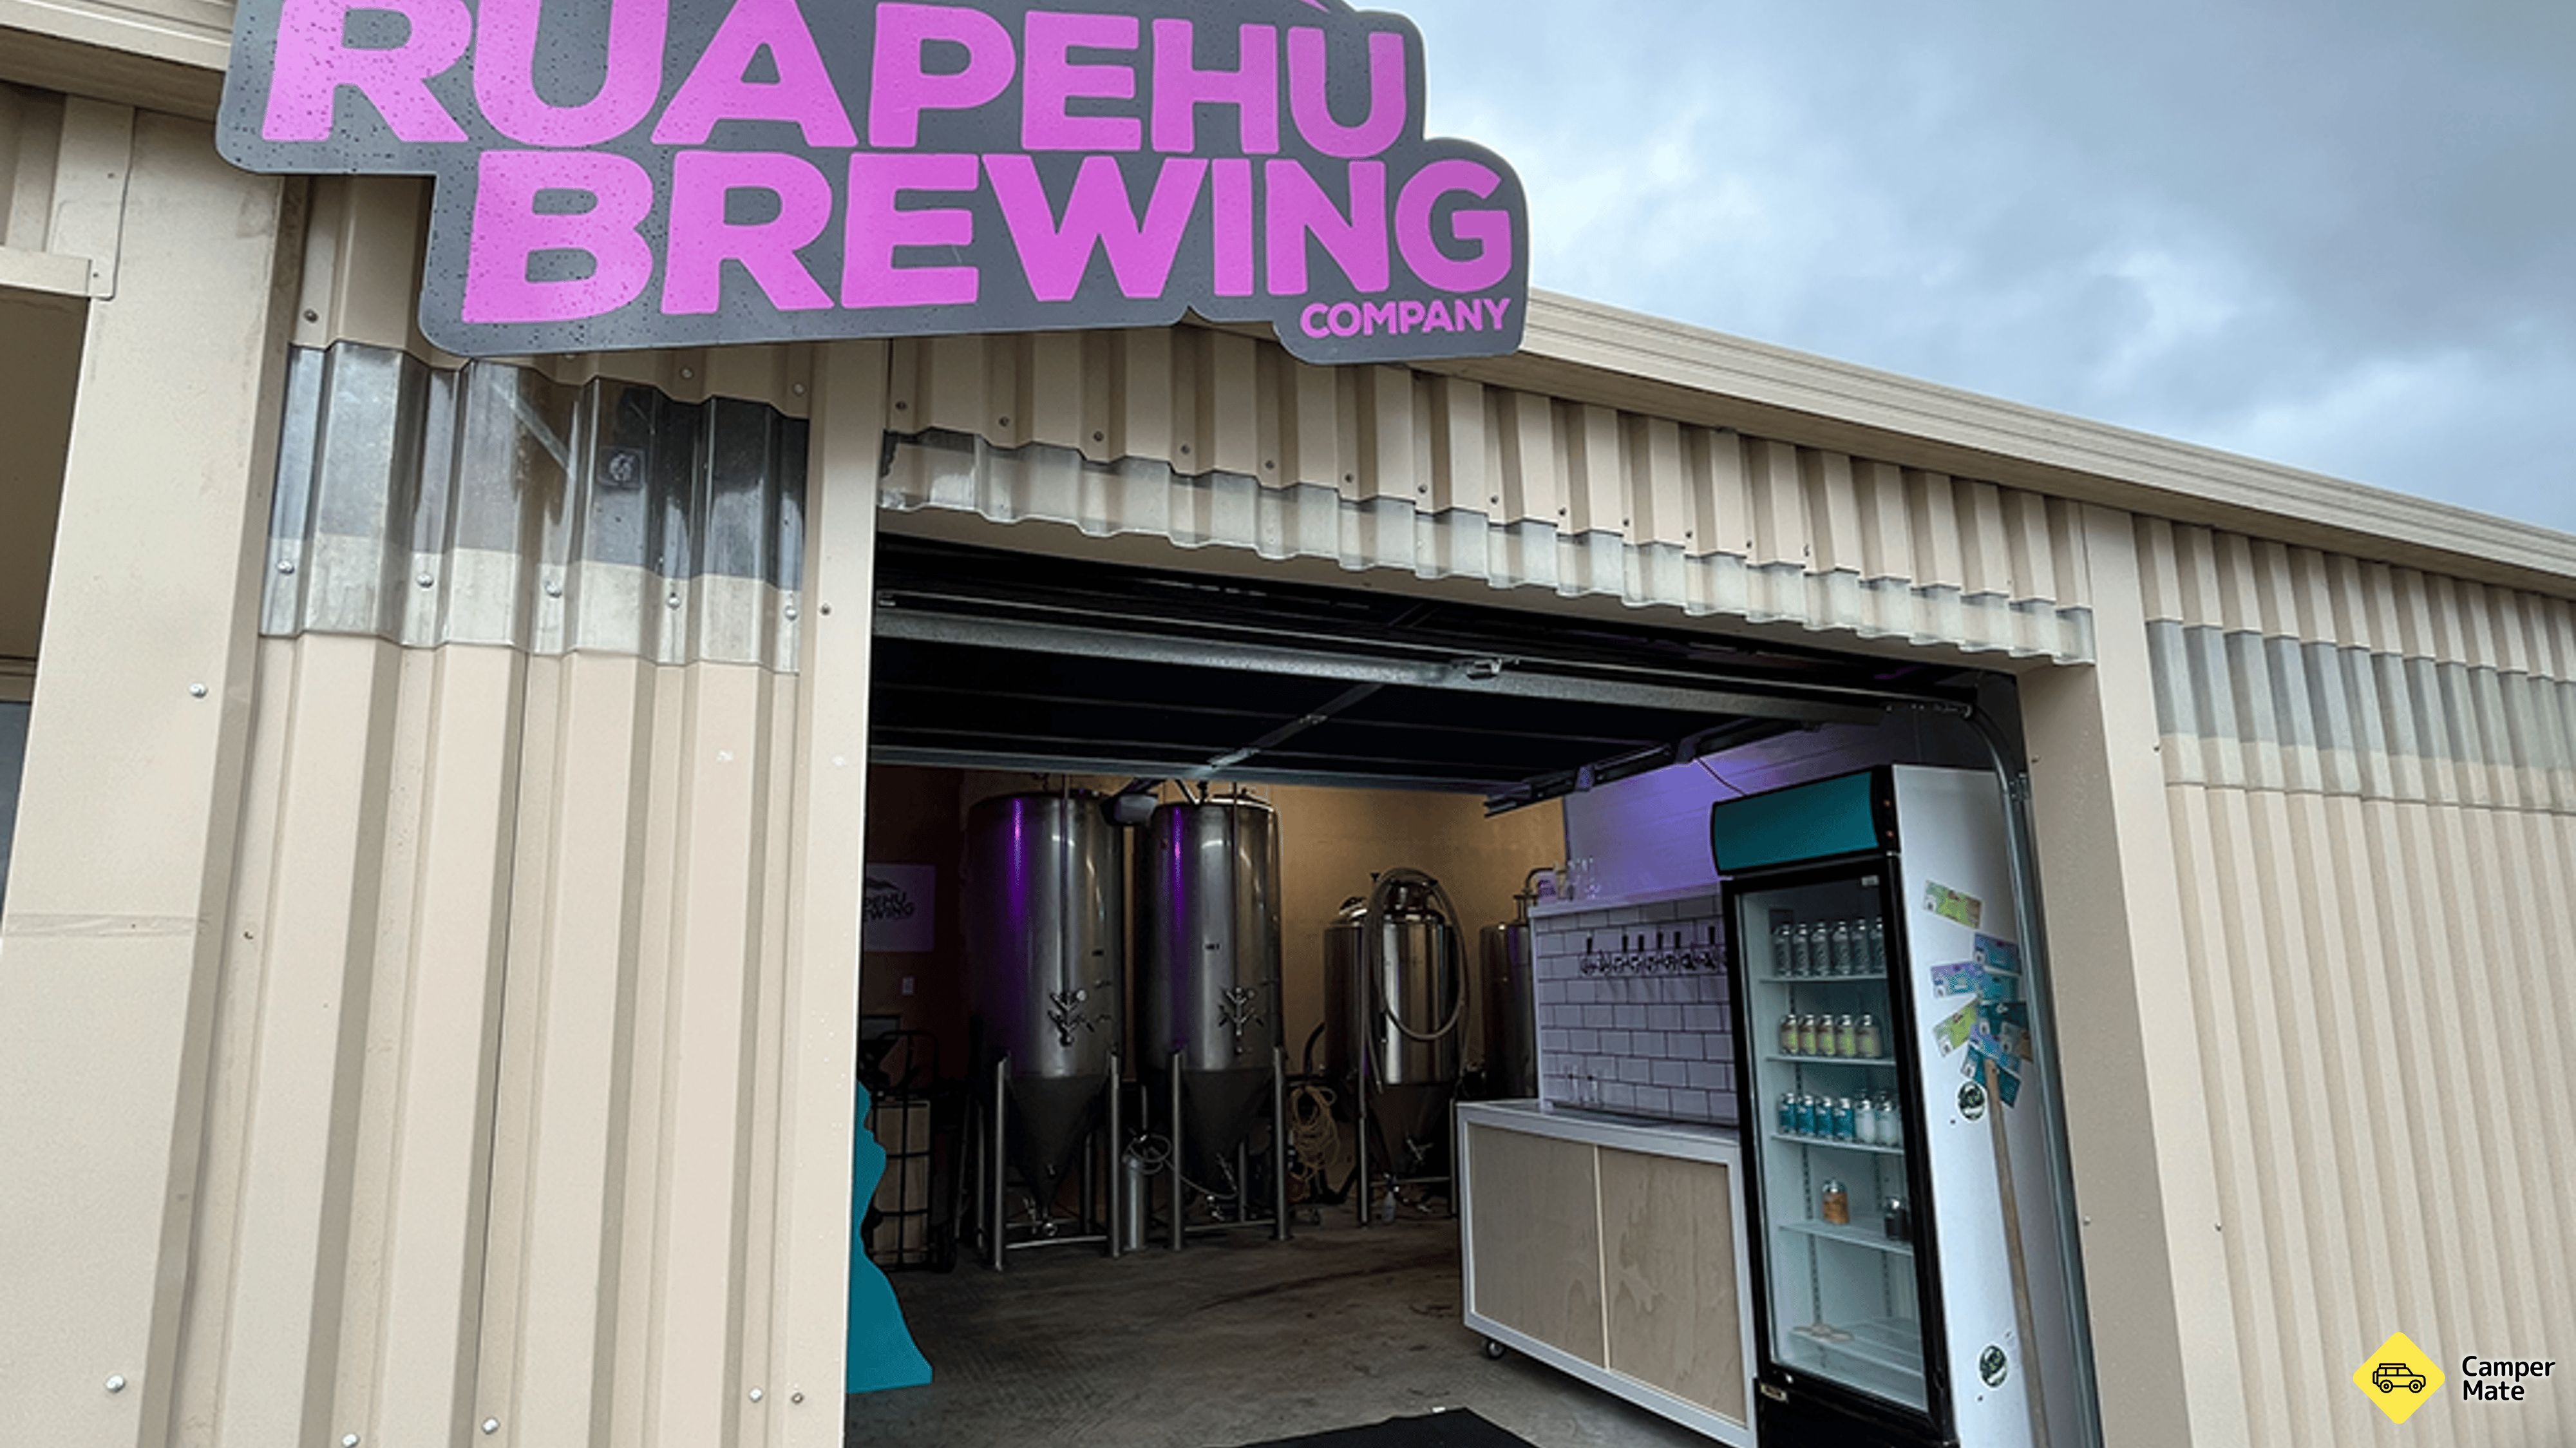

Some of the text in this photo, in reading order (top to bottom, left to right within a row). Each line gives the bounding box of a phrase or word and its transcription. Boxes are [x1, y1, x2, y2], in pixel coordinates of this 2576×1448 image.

[261, 0, 1407, 158] RUAPEHU
[462, 149, 1513, 323] BREWING
[1300, 298, 1511, 339] COMPANY
